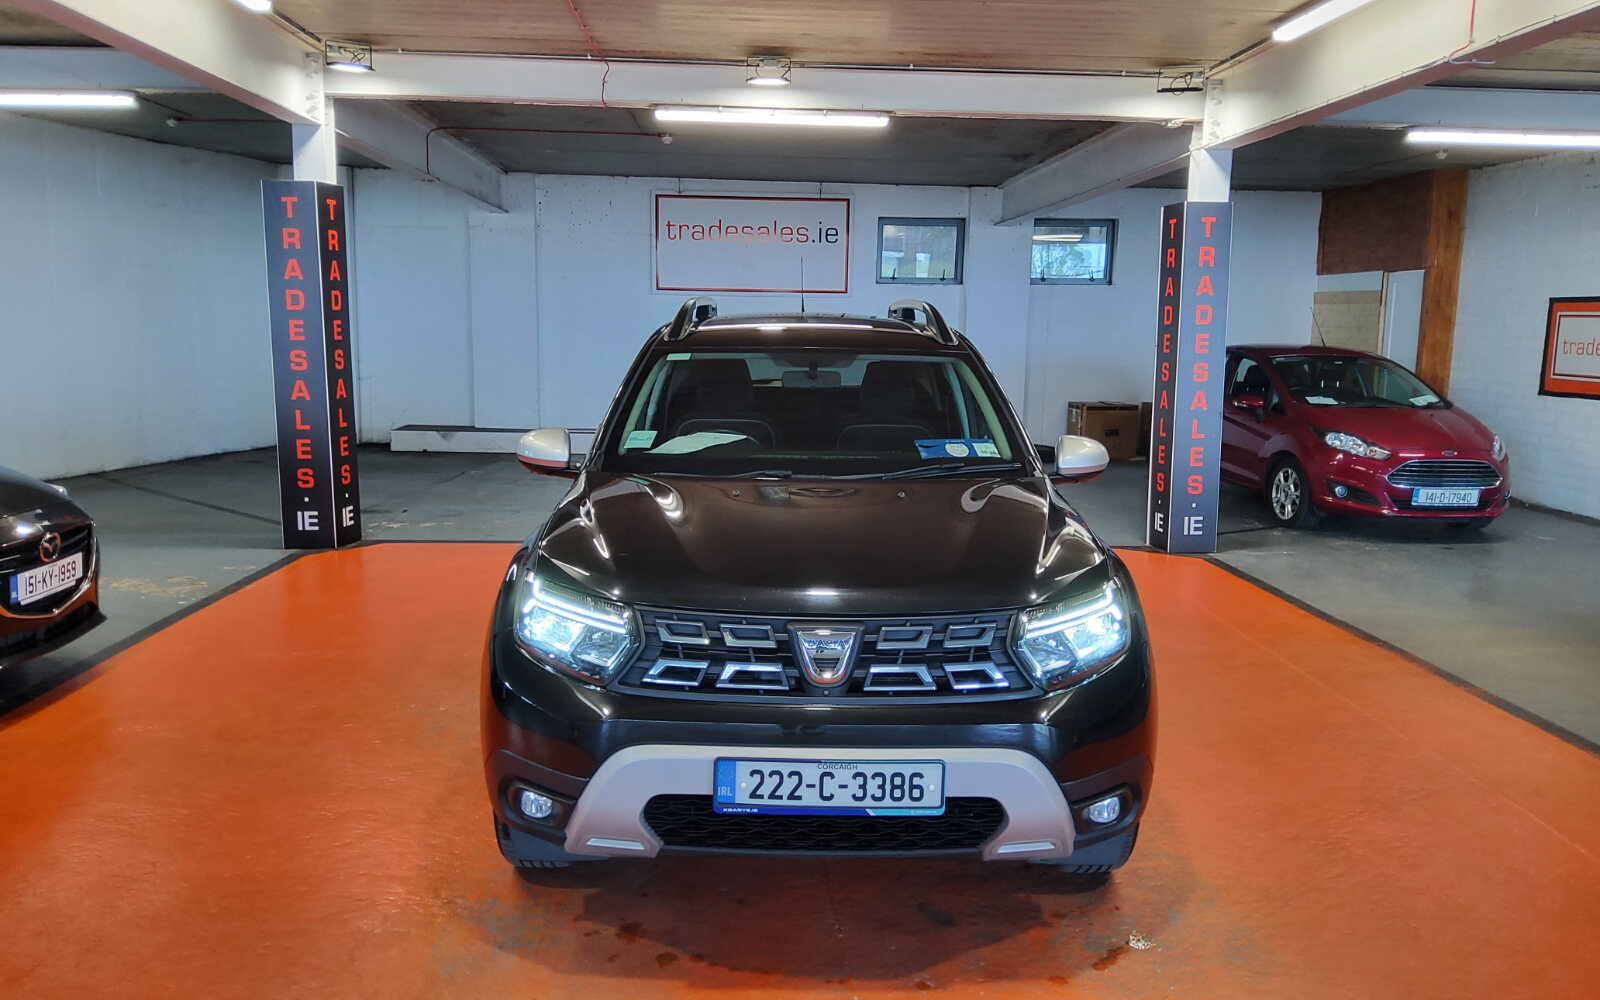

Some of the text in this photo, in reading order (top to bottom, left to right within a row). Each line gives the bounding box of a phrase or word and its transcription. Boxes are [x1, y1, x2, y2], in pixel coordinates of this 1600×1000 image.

[665, 218, 839, 244] tradesales.ie
[281, 196, 319, 531] TRADESALES.IE
[326, 198, 355, 528] TRADESALES.IE
[1154, 218, 1177, 533] TRADESALES.IE
[1183, 216, 1217, 536] TRADESALES.IE
[1425, 492, 1472, 504] 141-D-17940
[24, 560, 77, 596] 151-KY-1959
[817, 763, 858, 771] CORCAIGH
[717, 786, 733, 797] IRL
[748, 769, 925, 803] 222-C-3386
